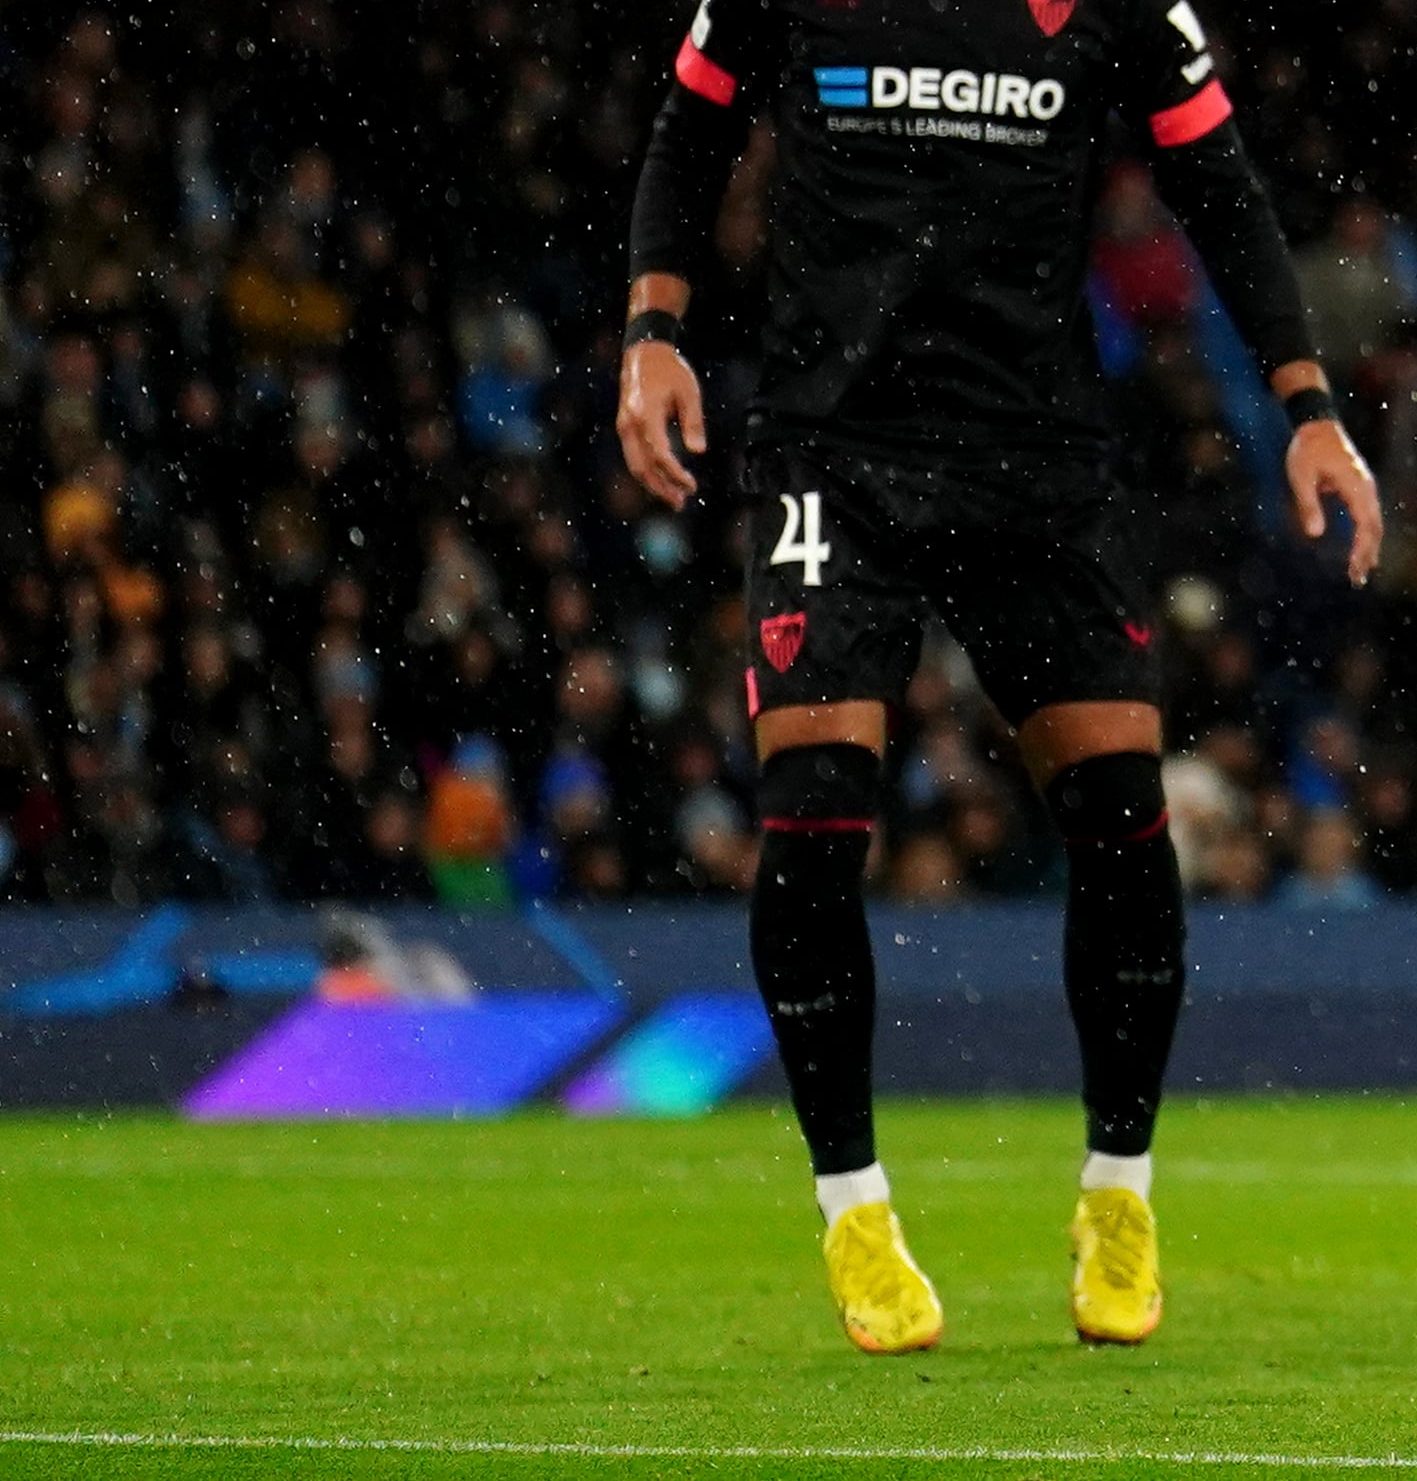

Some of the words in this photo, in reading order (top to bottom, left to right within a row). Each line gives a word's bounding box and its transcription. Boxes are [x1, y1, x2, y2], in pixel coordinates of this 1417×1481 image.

[871, 66, 1065, 120] DEGIRO
[905, 120, 982, 142] LEADING
[769, 490, 831, 587] 4
